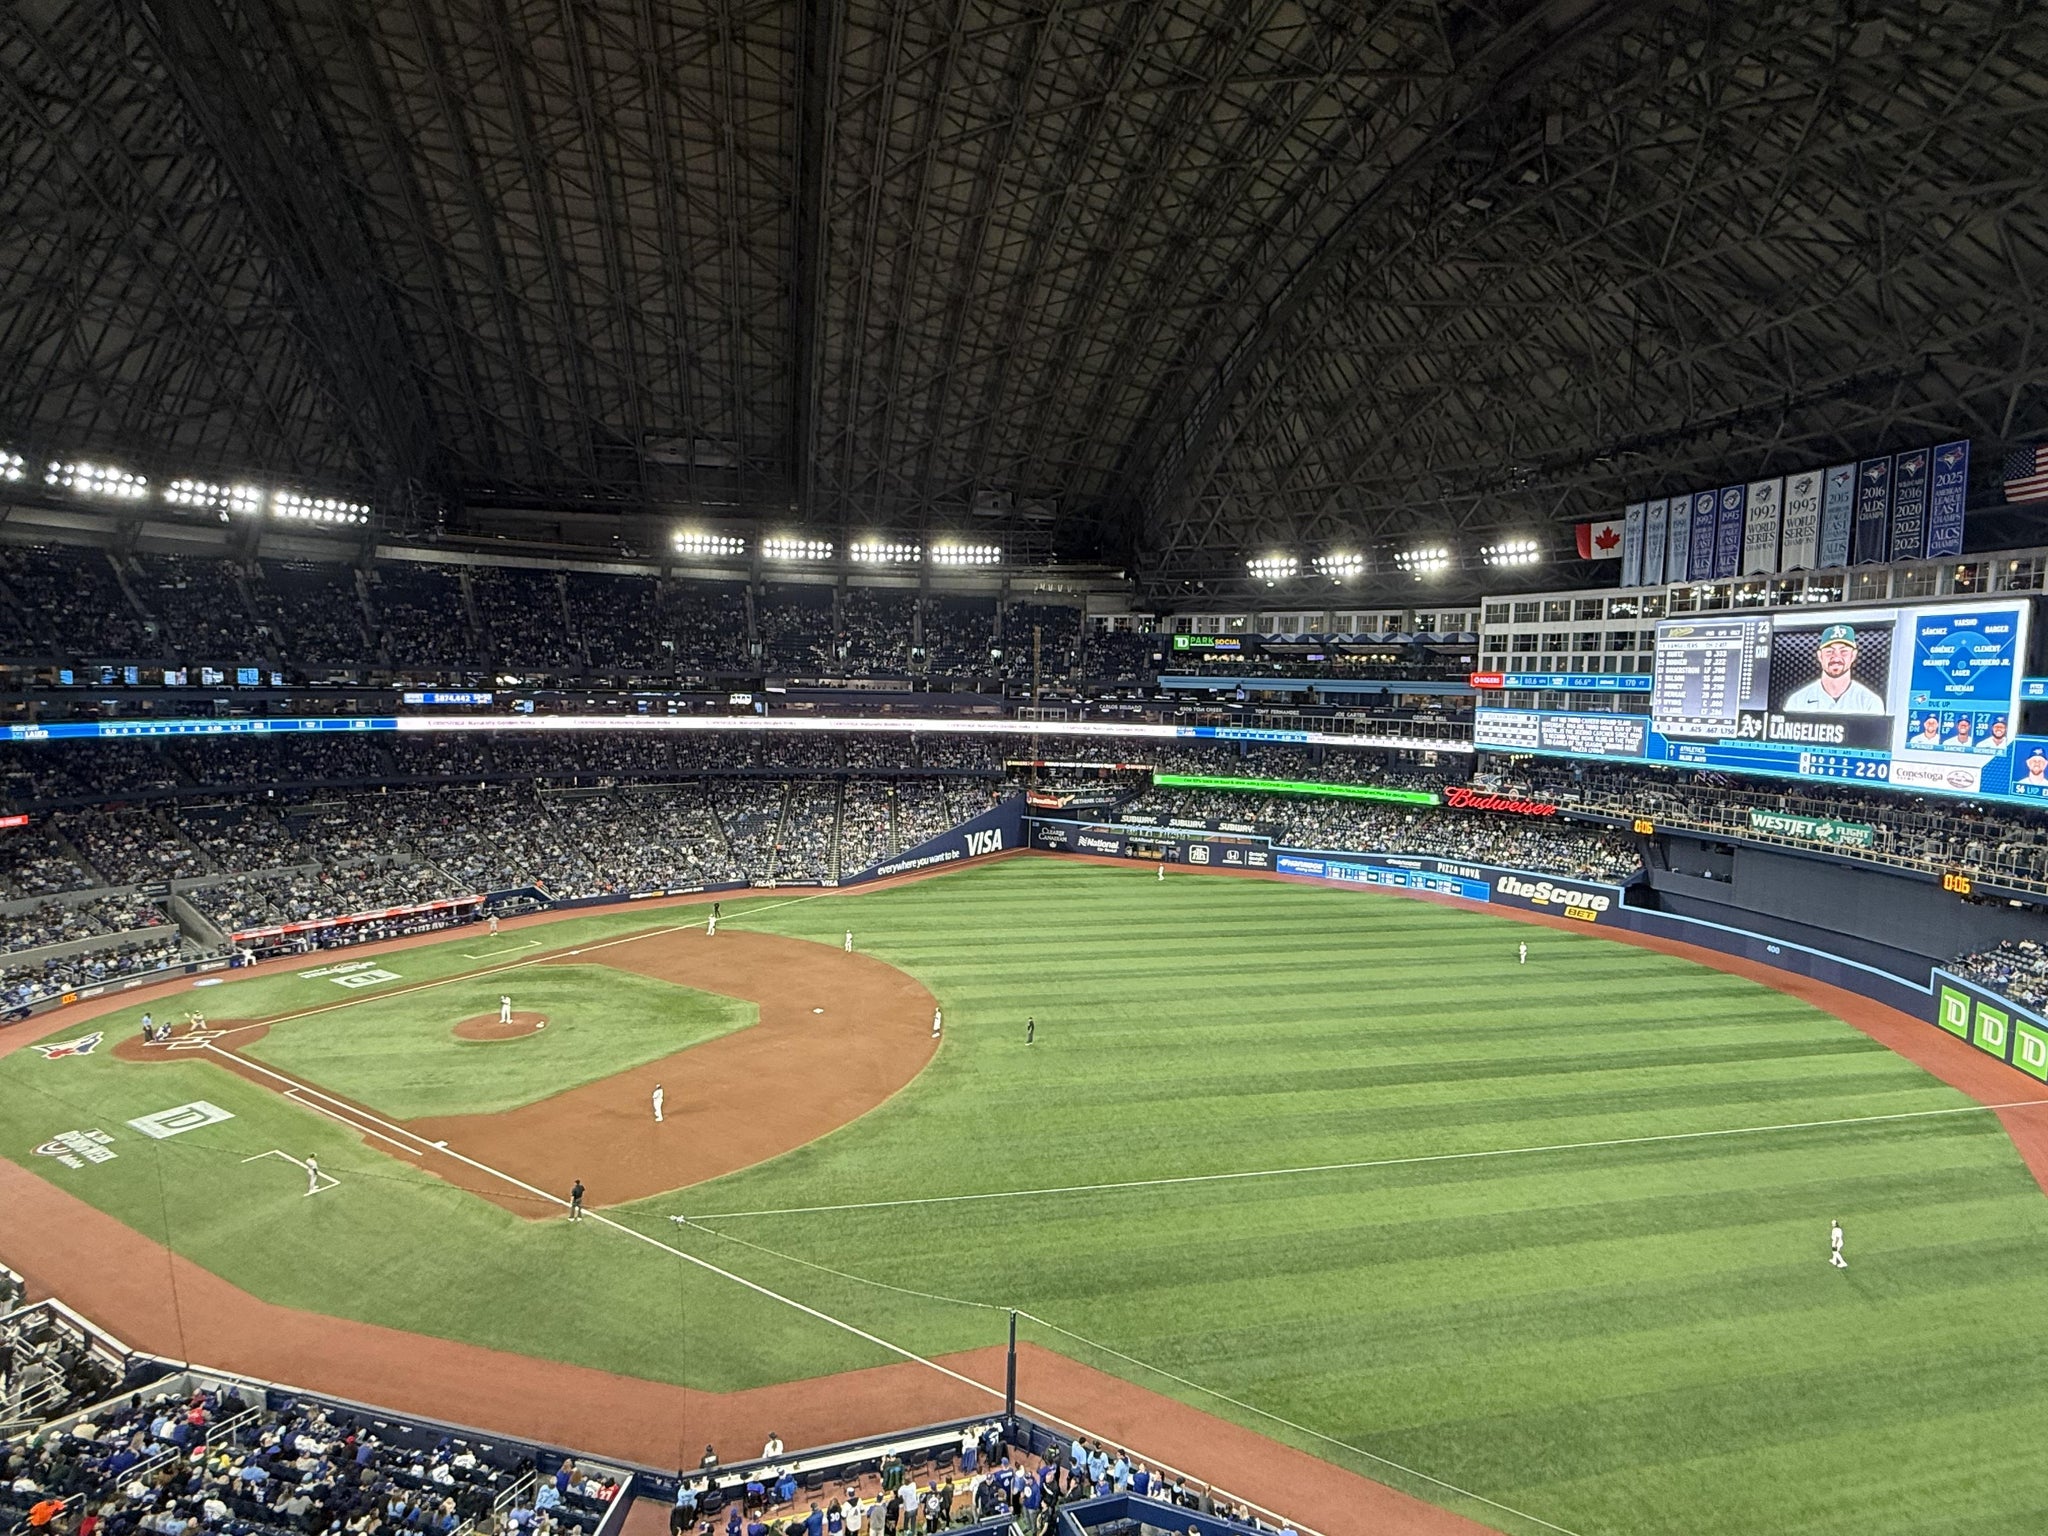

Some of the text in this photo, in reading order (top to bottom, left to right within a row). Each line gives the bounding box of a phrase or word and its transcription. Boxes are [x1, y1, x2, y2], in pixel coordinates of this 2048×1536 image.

[1936, 472, 1963, 487] 2025
[1862, 487, 1885, 499] 2016
[1899, 487, 1922, 500] 2016
[1789, 497, 1816, 515] 1993
[1863, 500, 1884, 512] ALDS
[1896, 503, 1922, 518] 2020
[1934, 503, 1960, 516] EAST
[1750, 504, 1776, 522] 1992
[1696, 515, 1713, 525] 1992
[1786, 515, 1816, 528] WORLD
[1748, 522, 1776, 534] WORLD
[1784, 526, 1815, 539] SERIES
[1895, 520, 1921, 534] 2022
[1934, 527, 1960, 540] ALCS
[1746, 532, 1775, 545] SERIES
[1894, 537, 1920, 551] 2025
[1758, 622, 1769, 634] 23
[1985, 625, 2009, 633] BARGER
[1175, 637, 1189, 648] TD
[1190, 637, 1214, 645] PARK
[1974, 645, 2001, 653] CLEMENT
[1755, 646, 1768, 658] DH
[1910, 711, 1918, 719] 4
[1944, 712, 1955, 720] 12
[1977, 714, 1990, 722] 27
[1737, 714, 1762, 738] A's
[1769, 722, 1844, 743] LANGELIERS
[1842, 758, 1848, 766] 2
[1896, 767, 1943, 781] Conestoga
[2016, 785, 2025, 793] 56
[1444, 786, 1556, 816] Budweiser
[1121, 815, 1157, 824] SUBWAY
[1169, 819, 1206, 828] SUBWAY
[1752, 814, 1816, 836] WESTJET
[1219, 823, 1255, 833] SUBWAY
[1634, 820, 1654, 834] 0:06
[1836, 826, 1870, 838] FLIGHT
[965, 829, 1002, 856] VISA
[1088, 839, 1119, 849] National
[877, 850, 960, 876] everywhere you want to be
[1437, 862, 1480, 879] PIZZA NOVA
[820, 879, 838, 887] VISA
[1944, 874, 1970, 893] 0:06
[1497, 877, 1610, 911] theScore
[1568, 908, 1594, 918] BET
[1767, 945, 1780, 954] 400
[1944, 995, 1966, 1027] TD
[1979, 1011, 2003, 1046] TD
[2019, 1030, 2046, 1067] TD
[830, 1512, 840, 1522] 30
